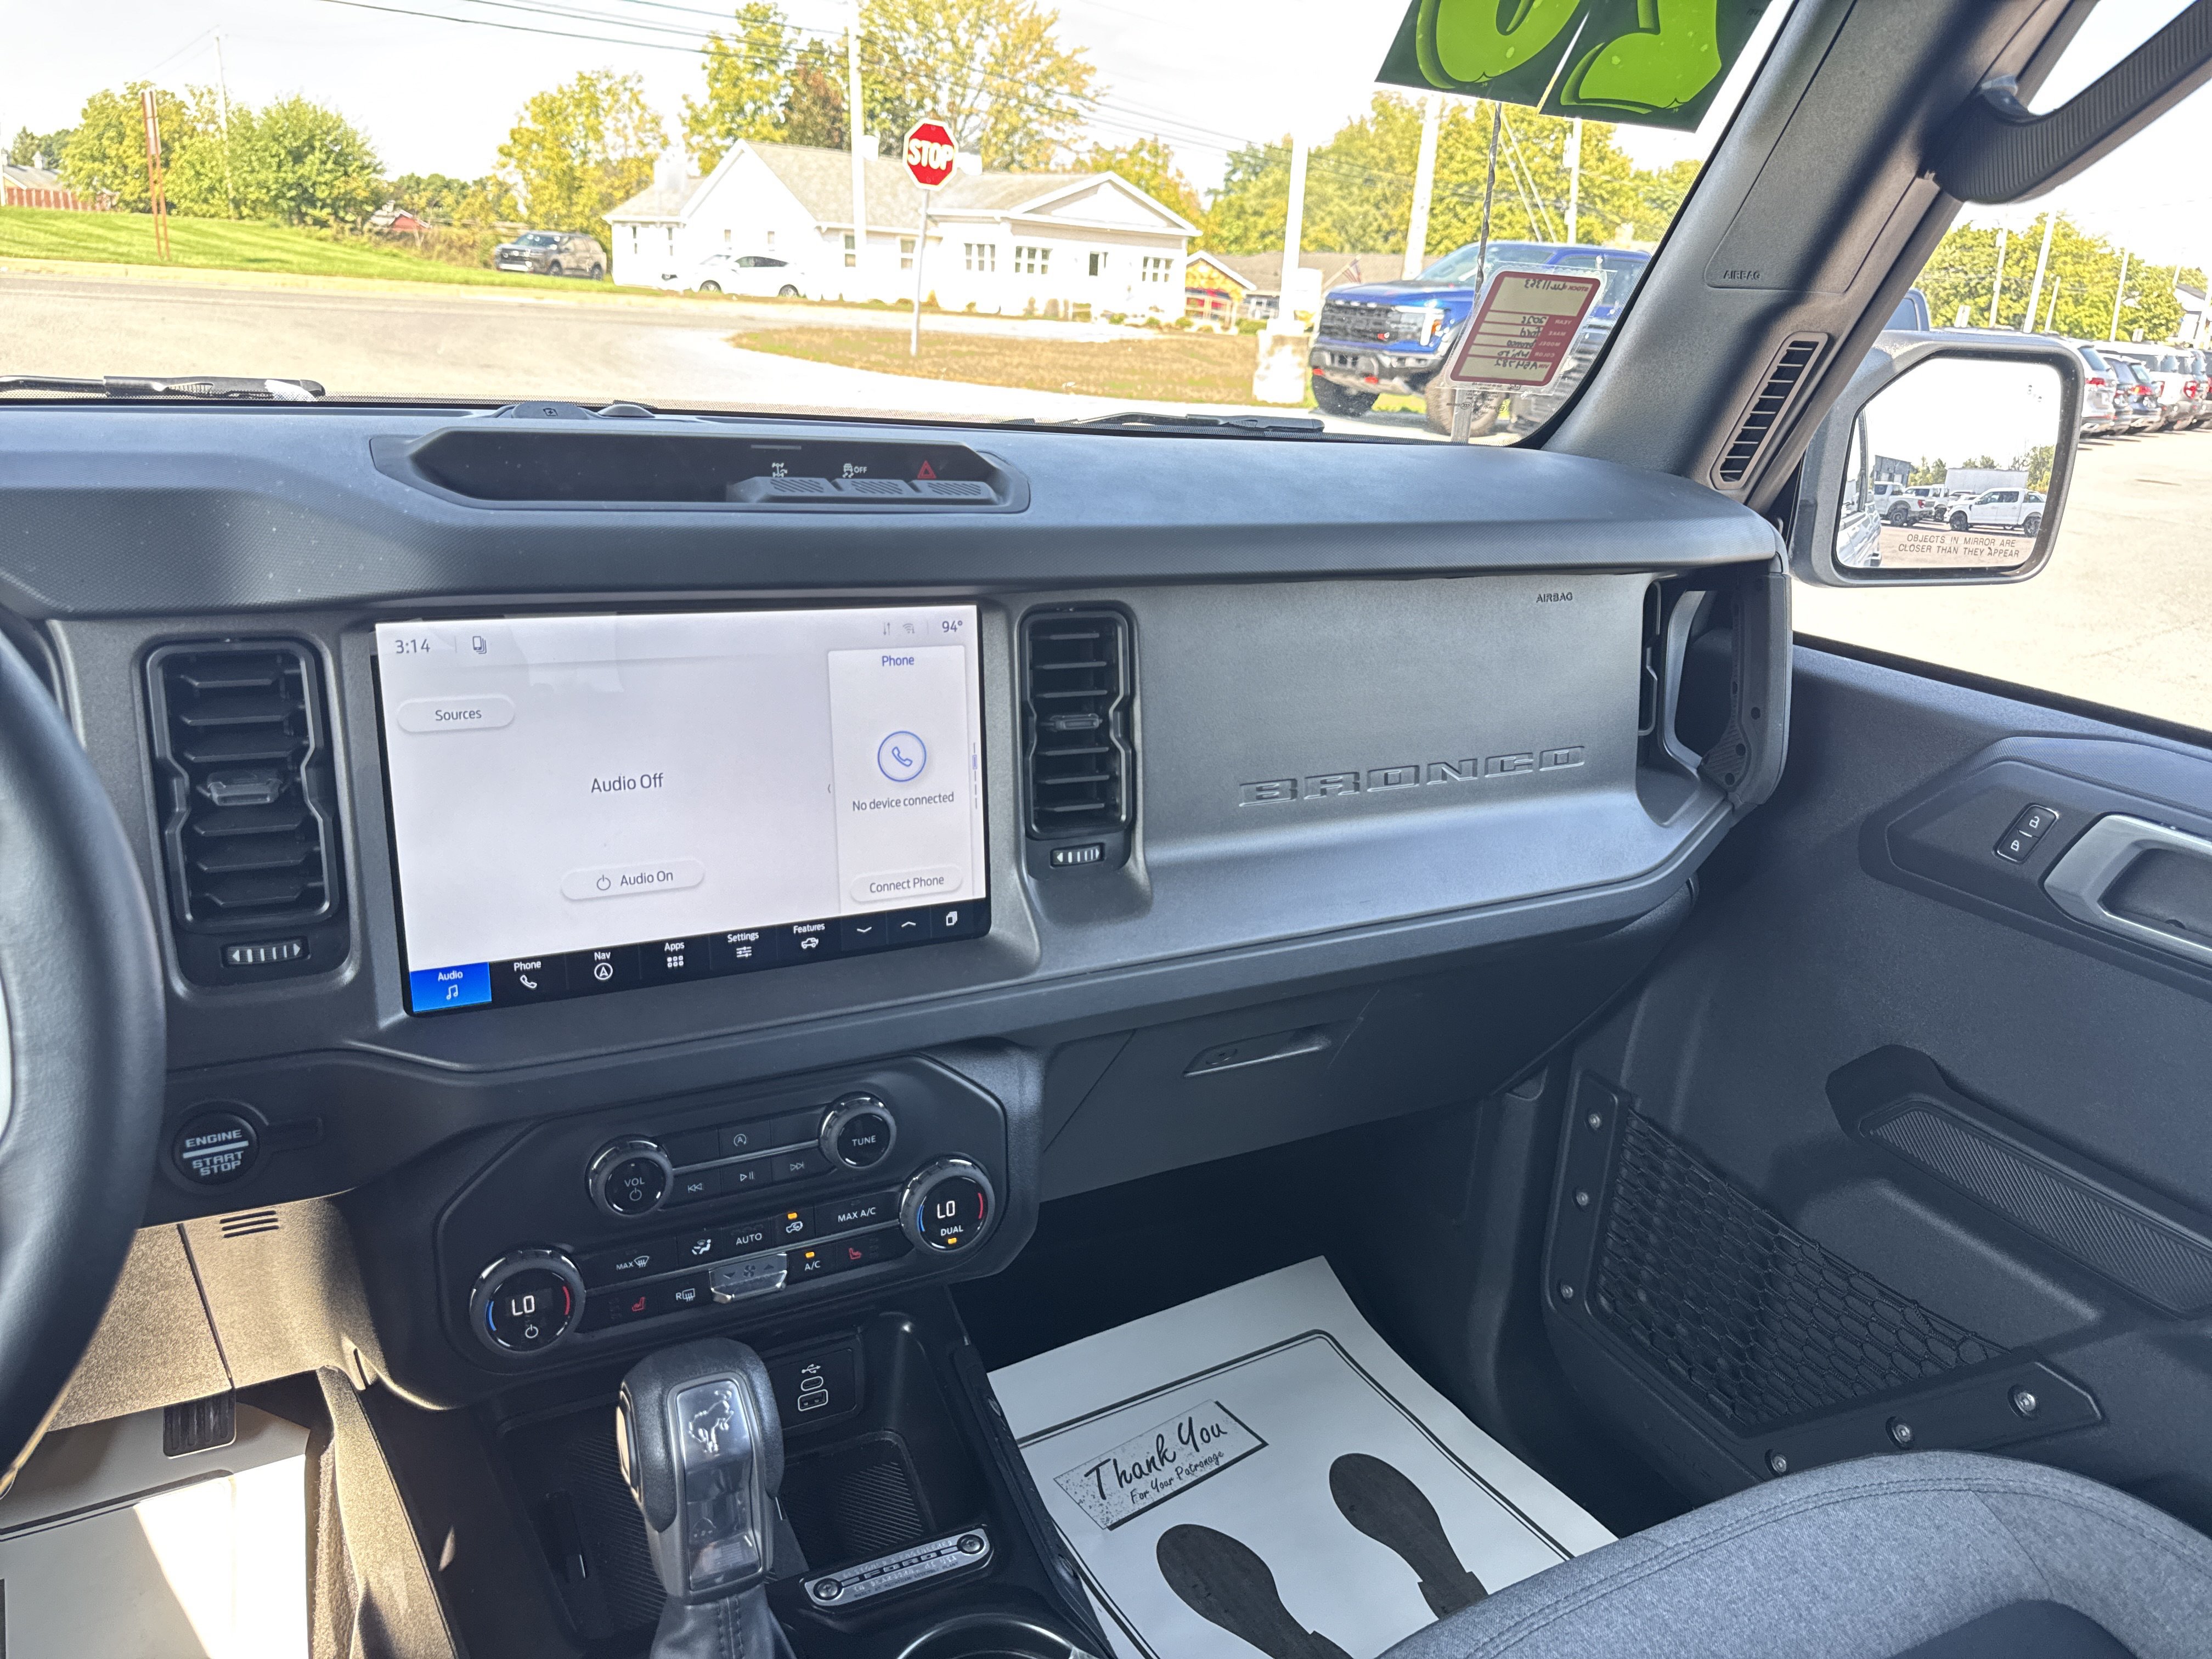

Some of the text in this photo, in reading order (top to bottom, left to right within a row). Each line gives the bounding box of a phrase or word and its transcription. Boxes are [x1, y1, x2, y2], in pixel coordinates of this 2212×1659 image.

[907, 138, 954, 171] STOP
[1723, 270, 1760, 280] AIRBAG
[1907, 534, 1945, 543] OBJECTS
[1964, 537, 1996, 546] MIRROR
[2000, 539, 2016, 548] ARE
[1898, 544, 2019, 557] CLOSER THAN THEY APPEAR
[1536, 592, 1573, 603] AIRBAG
[395, 639, 431, 654] 3:14
[882, 656, 915, 667] Phone
[435, 708, 482, 721] Sources
[590, 772, 664, 793] Audio Off
[1239, 745, 1585, 808] BRONCO
[853, 792, 954, 811] No device connected
[620, 870, 674, 887] Audio On
[870, 876, 944, 893] Connect Phone
[793, 923, 825, 934] Features
[727, 932, 759, 943] Settings
[664, 941, 685, 952] Apps
[594, 950, 611, 962] Nav
[514, 960, 542, 972] Phone
[437, 969, 464, 982] Audio
[185, 1129, 242, 1148] ENGINE
[851, 1135, 877, 1147] TUNE
[193, 1151, 244, 1169] START
[200, 1160, 241, 1176] STOP
[624, 1177, 645, 1188] VOL
[838, 1206, 876, 1223] MAX A/C
[936, 1200, 956, 1220] LO
[940, 1226, 963, 1237] DUAL
[736, 1233, 763, 1245] AUTO
[616, 1262, 634, 1271] MAX
[804, 1260, 821, 1272] A/C
[511, 1295, 535, 1316] LO
[1084, 1417, 1228, 1500] Thank You
[1130, 1450, 1224, 1504] For Your Patronage
[864, 1552, 938, 1579] FORD
